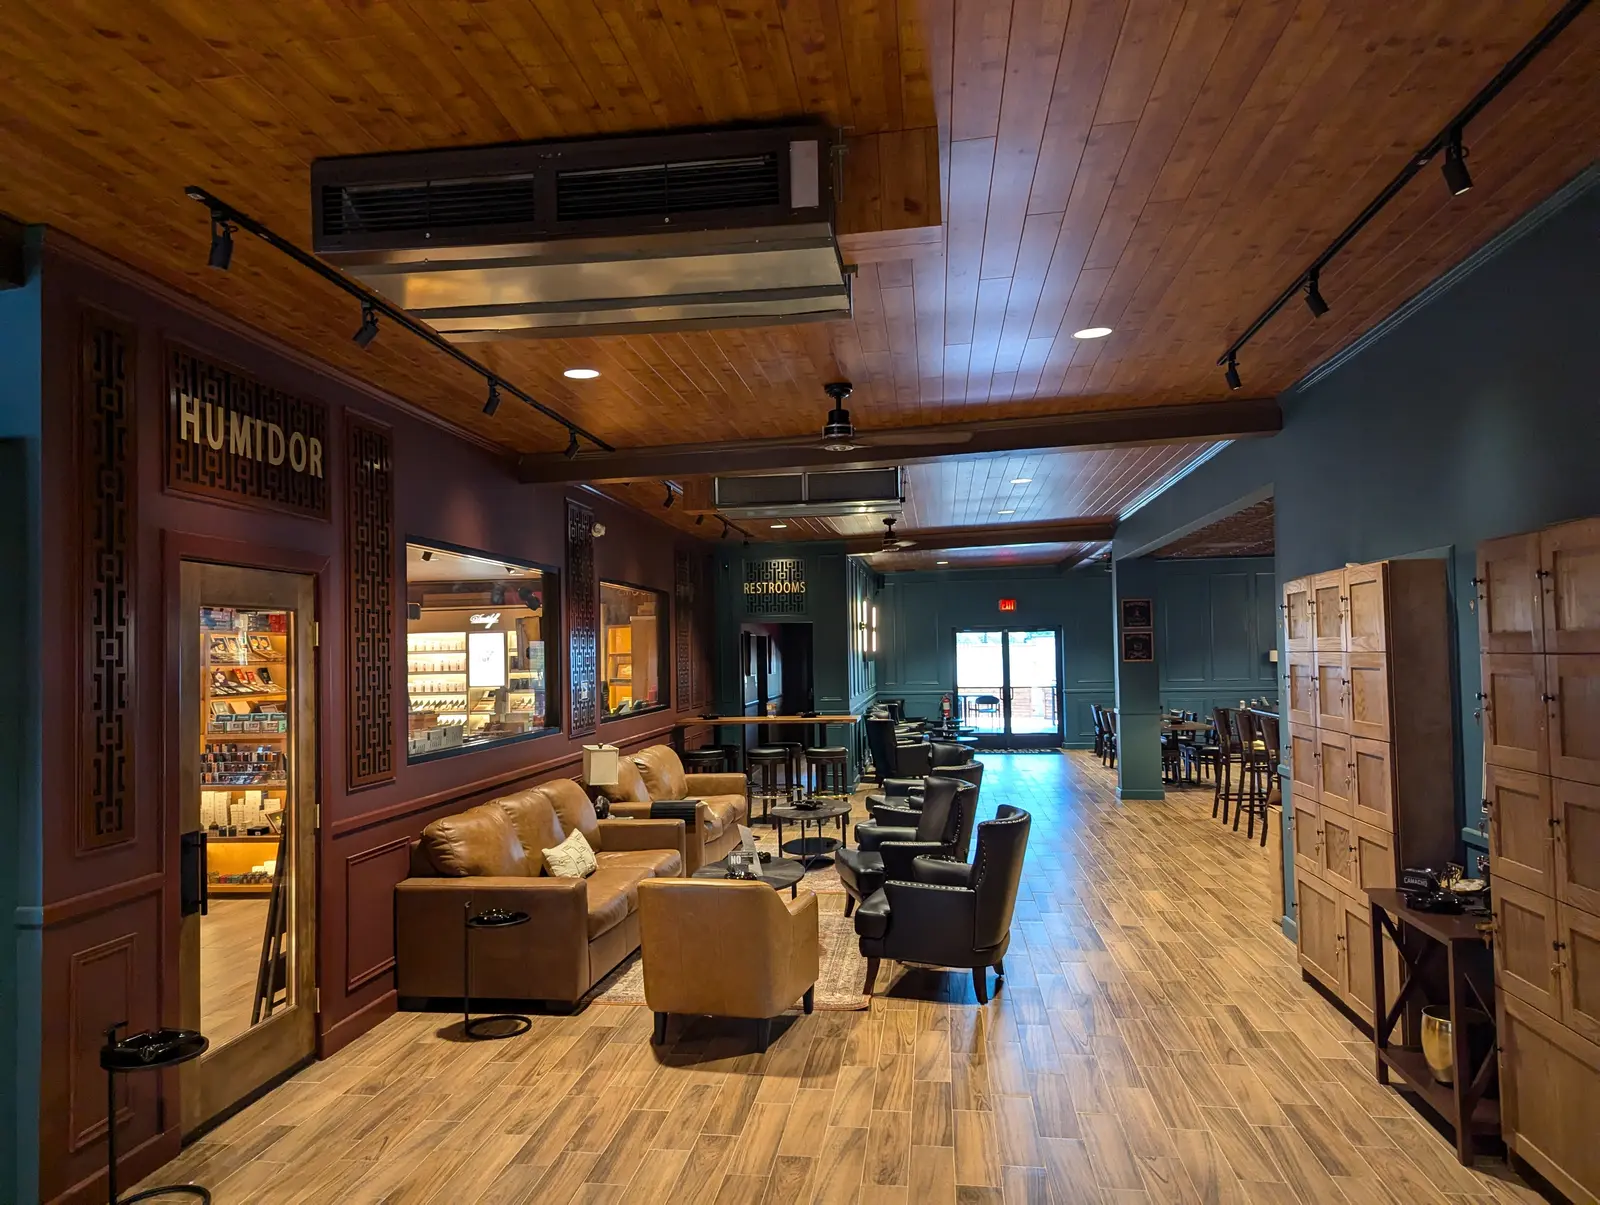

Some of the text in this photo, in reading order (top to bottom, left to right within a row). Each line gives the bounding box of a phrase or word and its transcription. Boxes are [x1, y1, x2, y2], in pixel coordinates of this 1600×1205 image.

[180, 393, 323, 479] HUMIDOR
[743, 581, 806, 594] RESTROOMS
[730, 855, 741, 865] NO
[1403, 877, 1428, 887] CAMACHO
